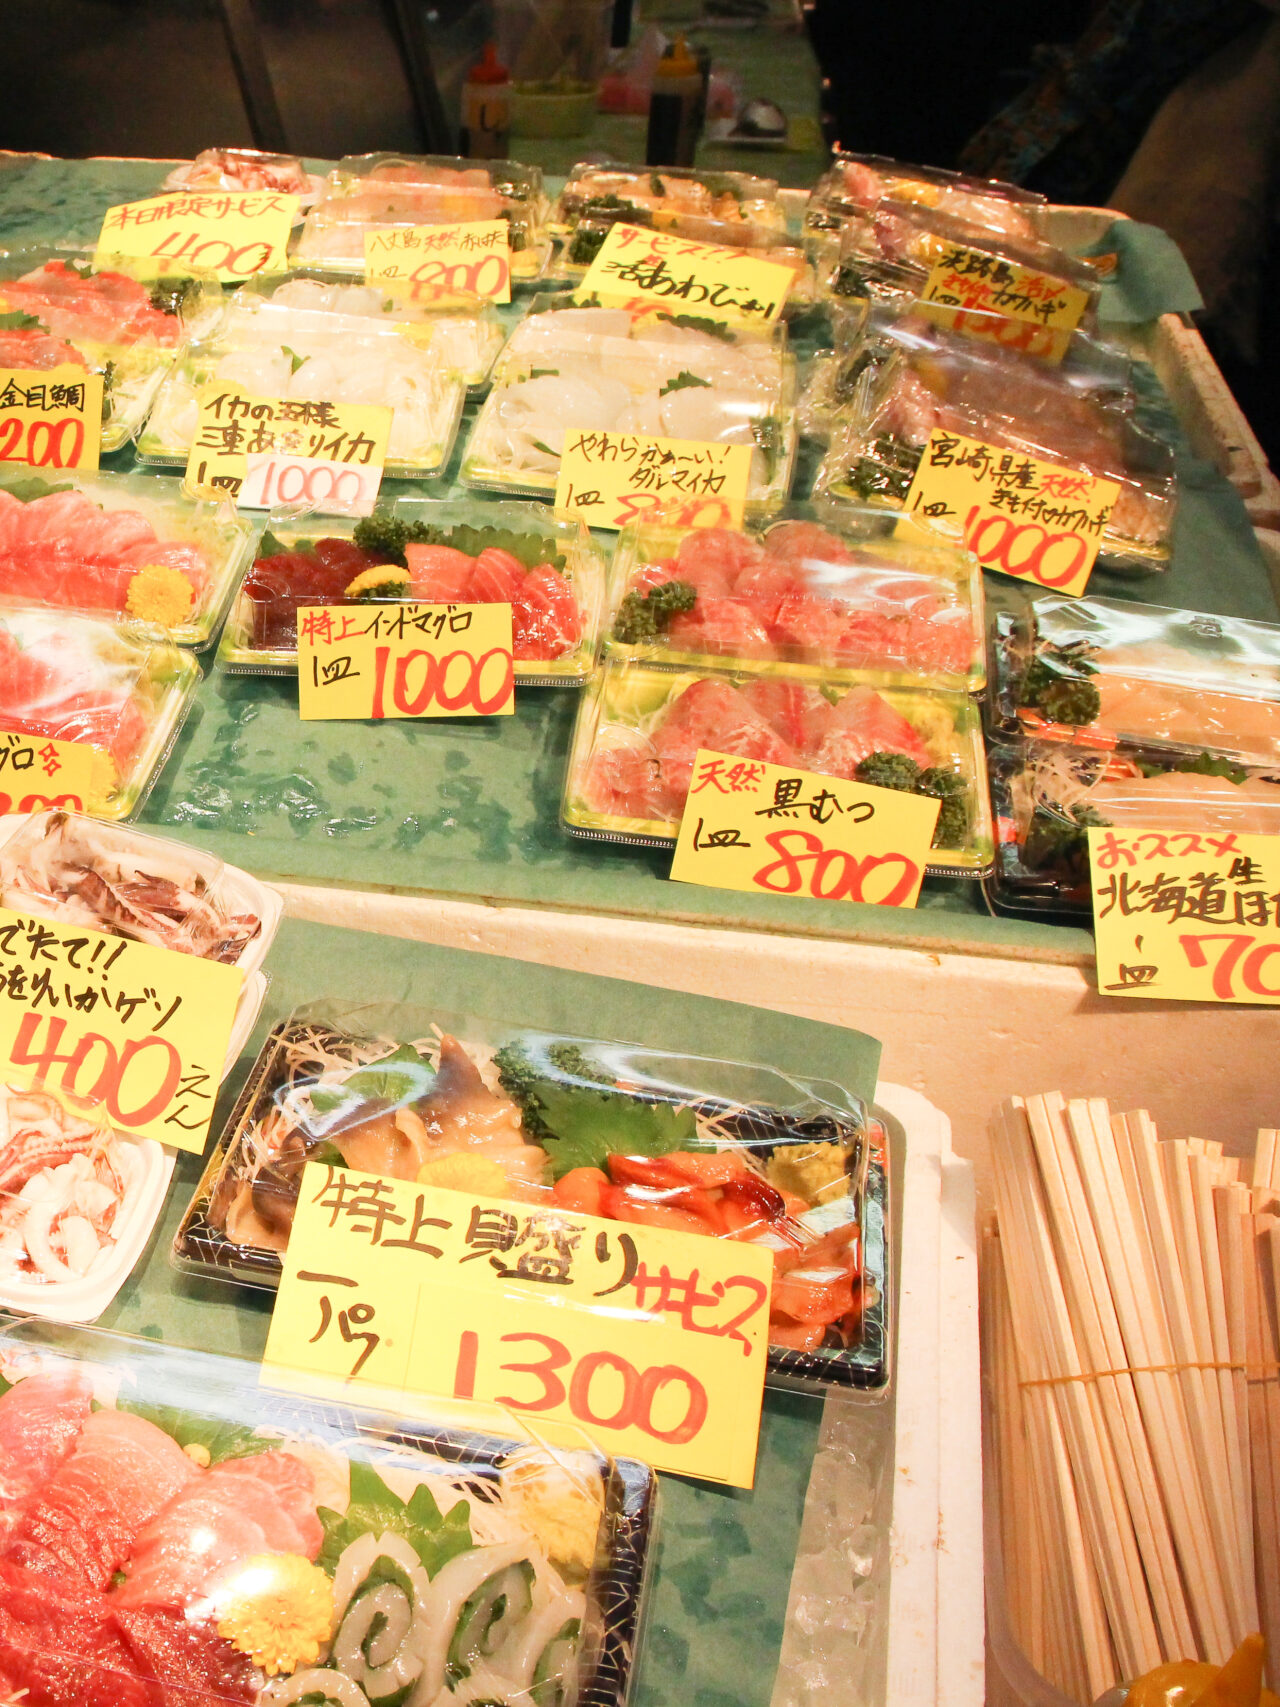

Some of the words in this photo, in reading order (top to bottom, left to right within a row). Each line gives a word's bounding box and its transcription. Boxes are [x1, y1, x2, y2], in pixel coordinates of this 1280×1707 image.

[259, 461, 364, 508] 1000
[565, 483, 605, 509] 1皿
[963, 504, 1089, 589] 1000
[312, 655, 361, 688] 1皿
[371, 645, 514, 719] 1000
[692, 817, 752, 852] 1皿
[752, 828, 920, 908] 800
[8, 1011, 183, 1128] 400
[453, 1329, 709, 1446] 1300
